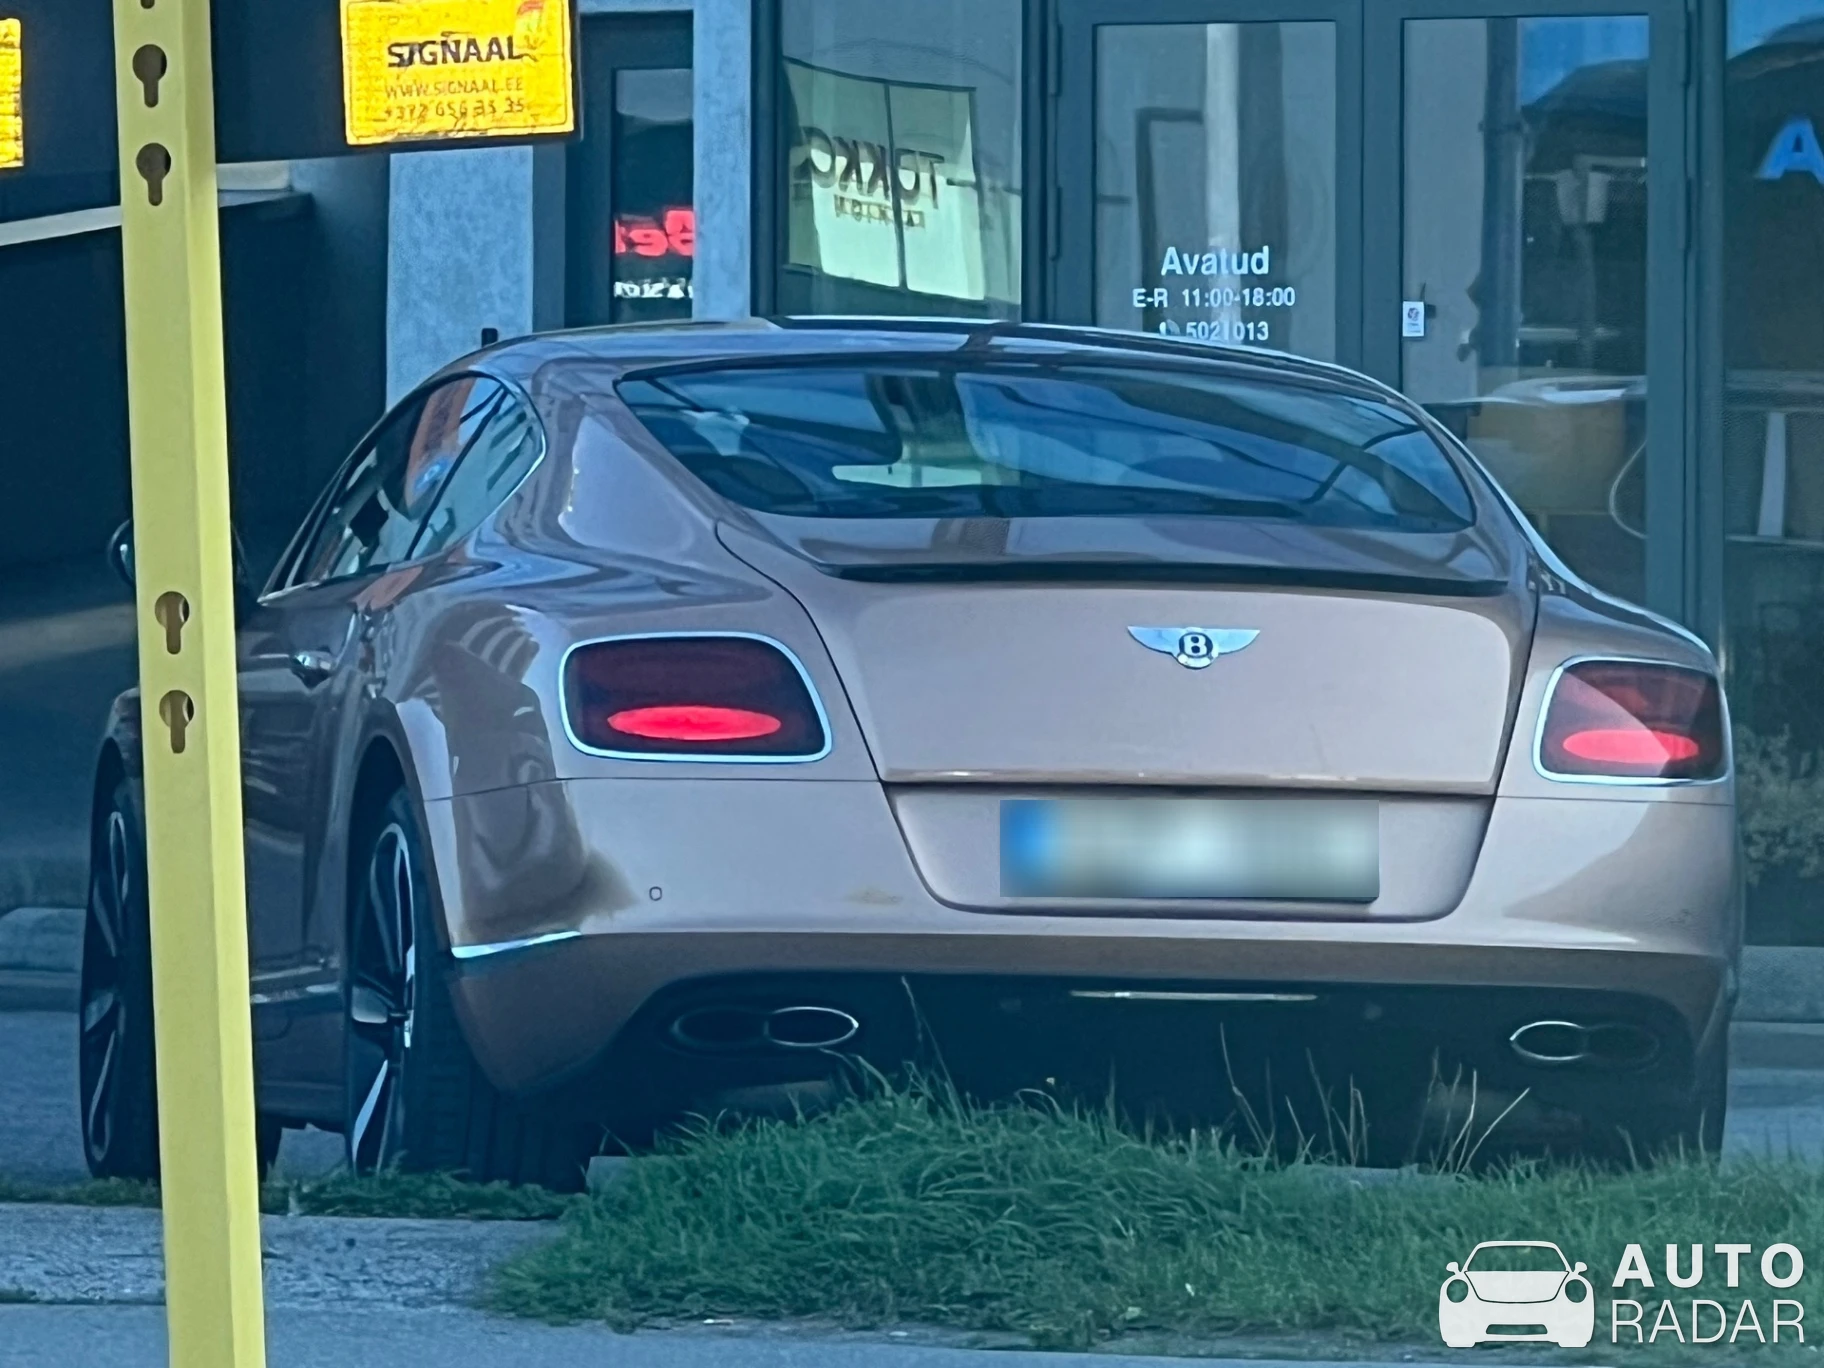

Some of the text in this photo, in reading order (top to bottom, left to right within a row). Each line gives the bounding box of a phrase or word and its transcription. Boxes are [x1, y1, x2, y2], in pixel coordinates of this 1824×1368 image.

[387, 35, 523, 68] SIGNAAL
[1161, 245, 1269, 275] Avatud
[1132, 287, 1296, 308] E-R 11:00-18:00
[1183, 634, 1208, 656] B
